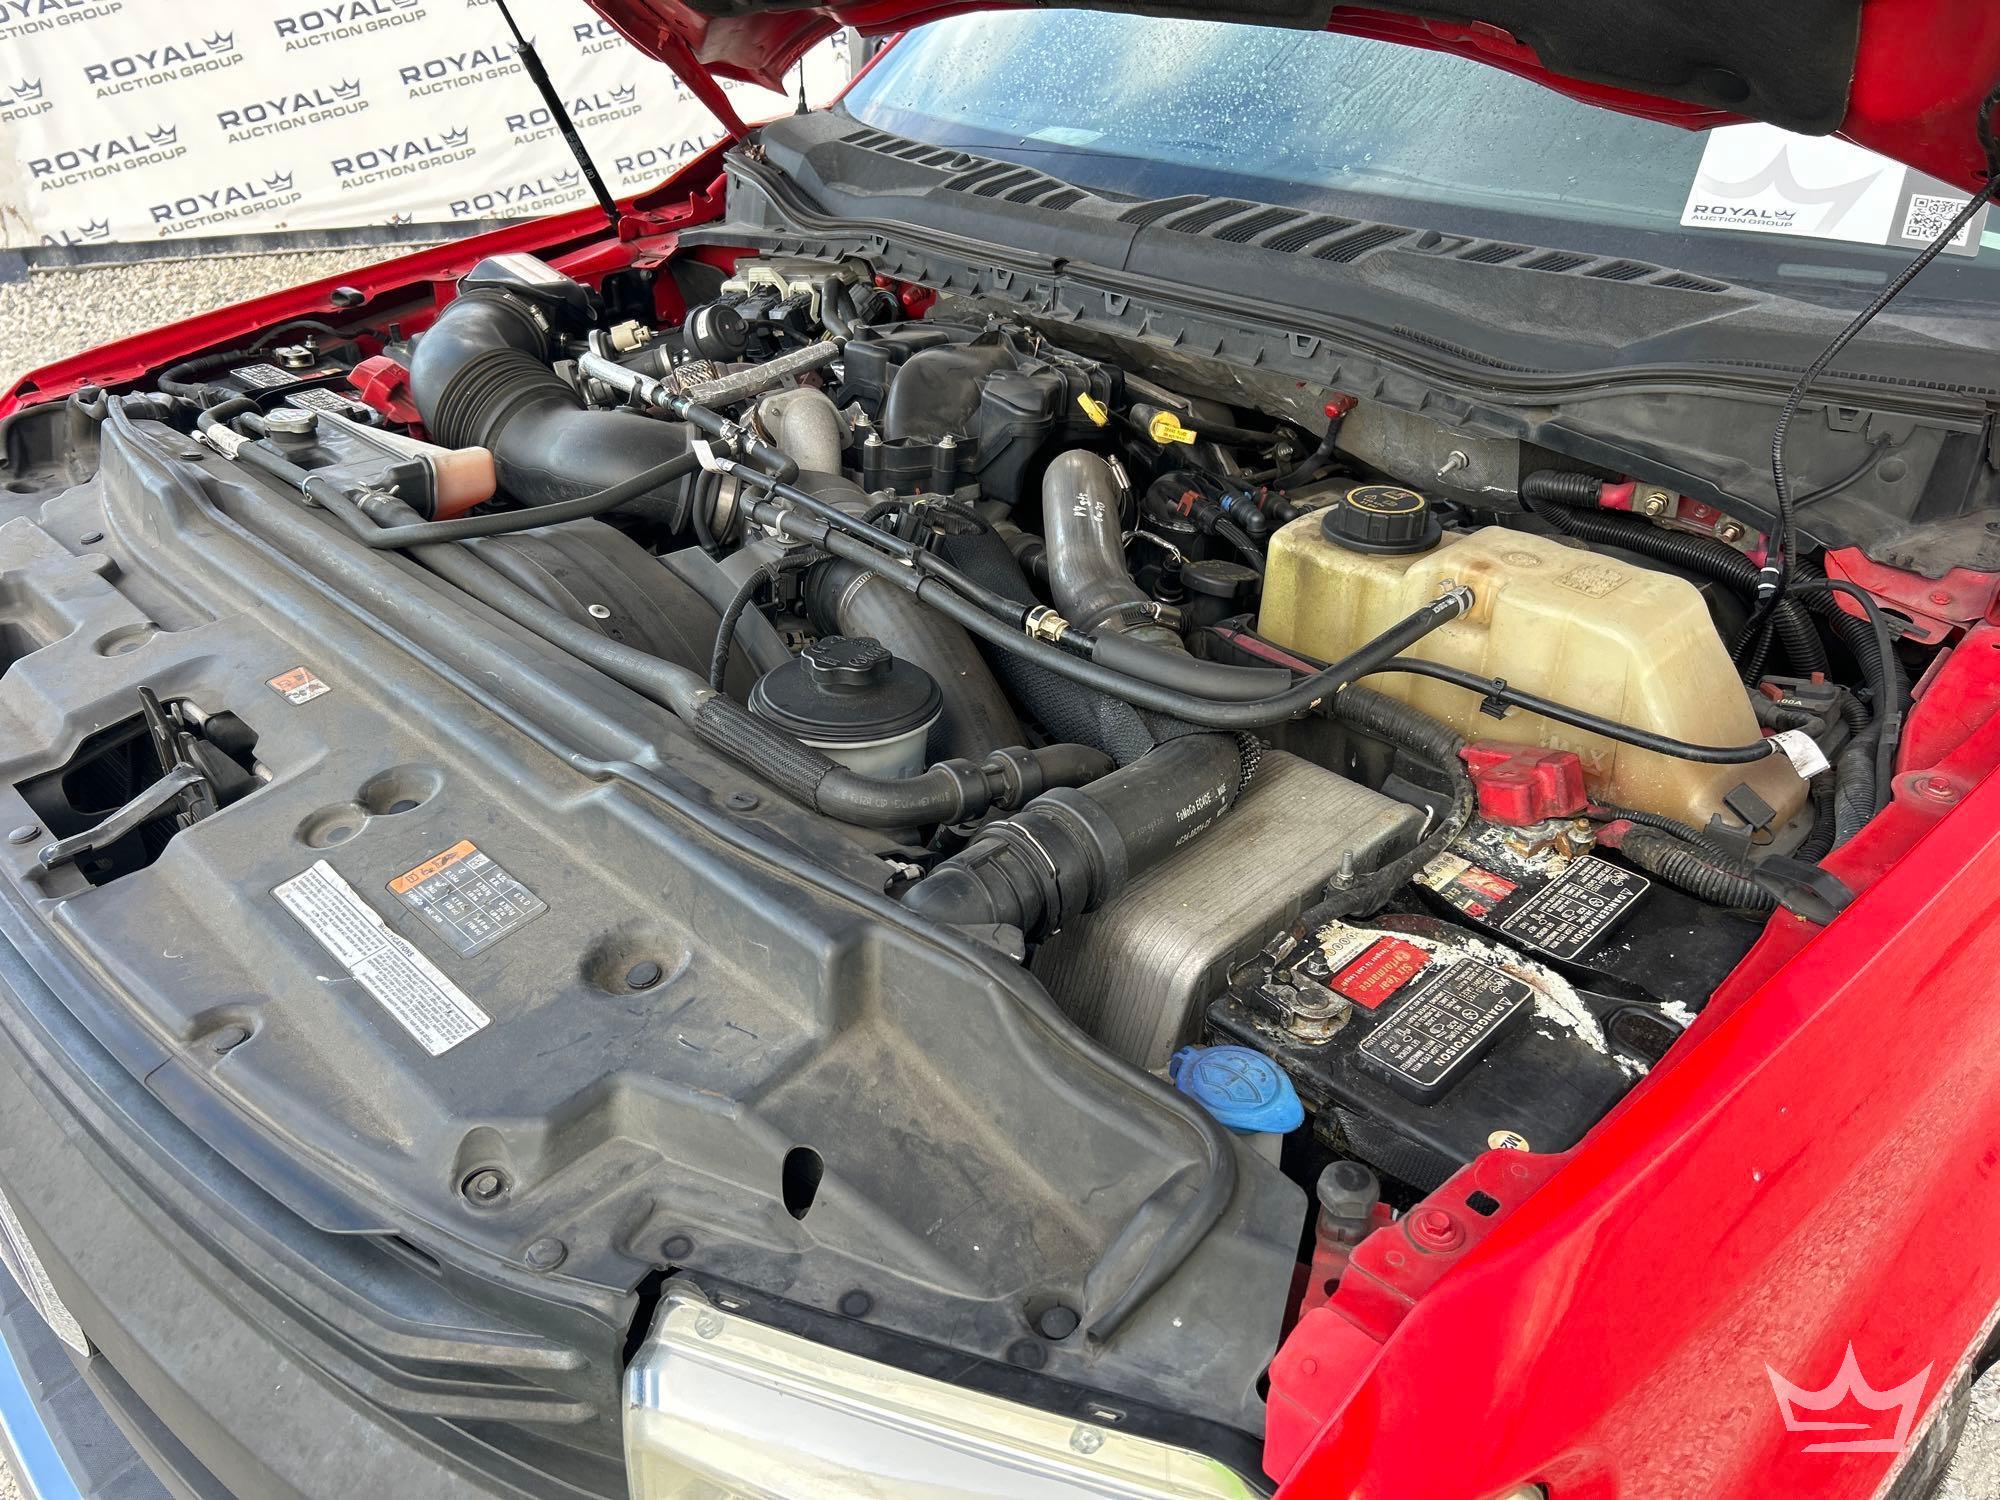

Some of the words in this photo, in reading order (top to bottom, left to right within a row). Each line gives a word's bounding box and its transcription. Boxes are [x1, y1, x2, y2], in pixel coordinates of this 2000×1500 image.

[55, 2, 123, 27] GROUP
[274, 0, 393, 38] ROYAL
[285, 24, 364, 52] AUCTION
[366, 9, 427, 33] GROUP
[83, 42, 207, 84] ROYAL
[96, 70, 178, 98] AUCTION
[180, 53, 244, 78] GROUP
[398, 46, 512, 85] ROYAL
[409, 72, 484, 99] AUCTION
[217, 88, 335, 130] ROYAL
[228, 114, 306, 143] AUCTION
[308, 100, 370, 125] GROUP
[505, 94, 612, 133] ROAL
[587, 104, 643, 127] GROUP
[28, 135, 150, 178] ROYAL
[41, 162, 121, 192] AUCTION
[124, 146, 188, 171] GROUP
[331, 136, 443, 177] ROYAL
[341, 162, 416, 190] AUCTION
[417, 147, 476, 170] GROUP
[615, 137, 716, 174] ROYAL
[149, 181, 267, 223] ROYAL
[163, 209, 239, 236] AUCTION
[241, 192, 302, 216] GROUP
[450, 178, 555, 217] ROYAL
[531, 188, 587, 210] GROUP
[1693, 204, 1773, 220] ROYAL
[1691, 214, 1749, 225] AUCTION
[1749, 219, 1793, 227] GROUP
[1567, 893, 1627, 945] DANGER/POISON
[1356, 948, 1413, 995] Performance
[1376, 973, 1401, 993] Year
[1394, 962, 1414, 977] Six
[1431, 1002, 1505, 1067] DANGER/POISON
